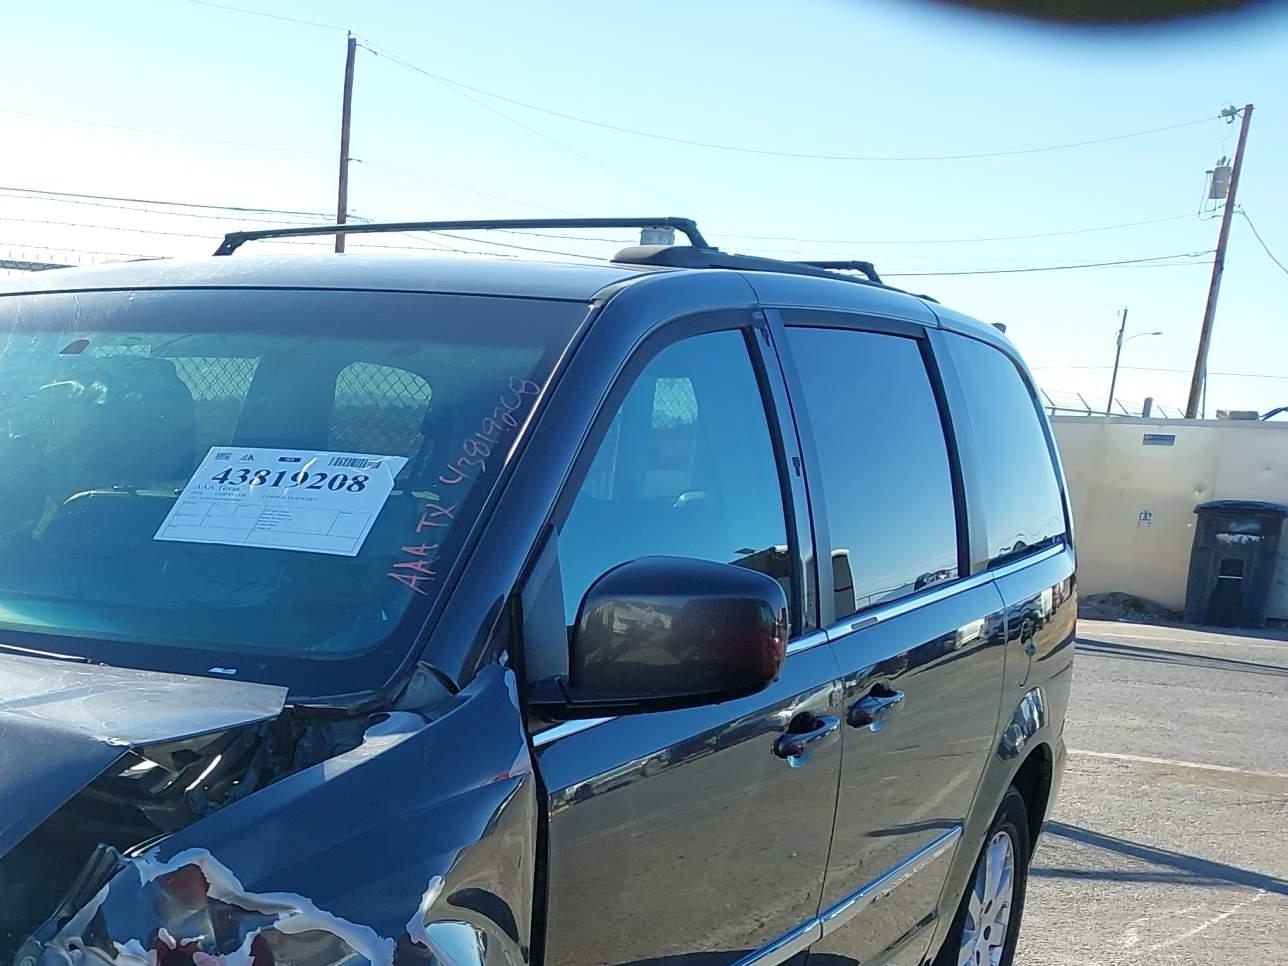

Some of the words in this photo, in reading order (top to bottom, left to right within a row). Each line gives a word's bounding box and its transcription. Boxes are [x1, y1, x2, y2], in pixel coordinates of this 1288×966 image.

[211, 466, 371, 494] 43819208
[415, 503, 457, 534] TX
[438, 376, 541, 486] 43819208
